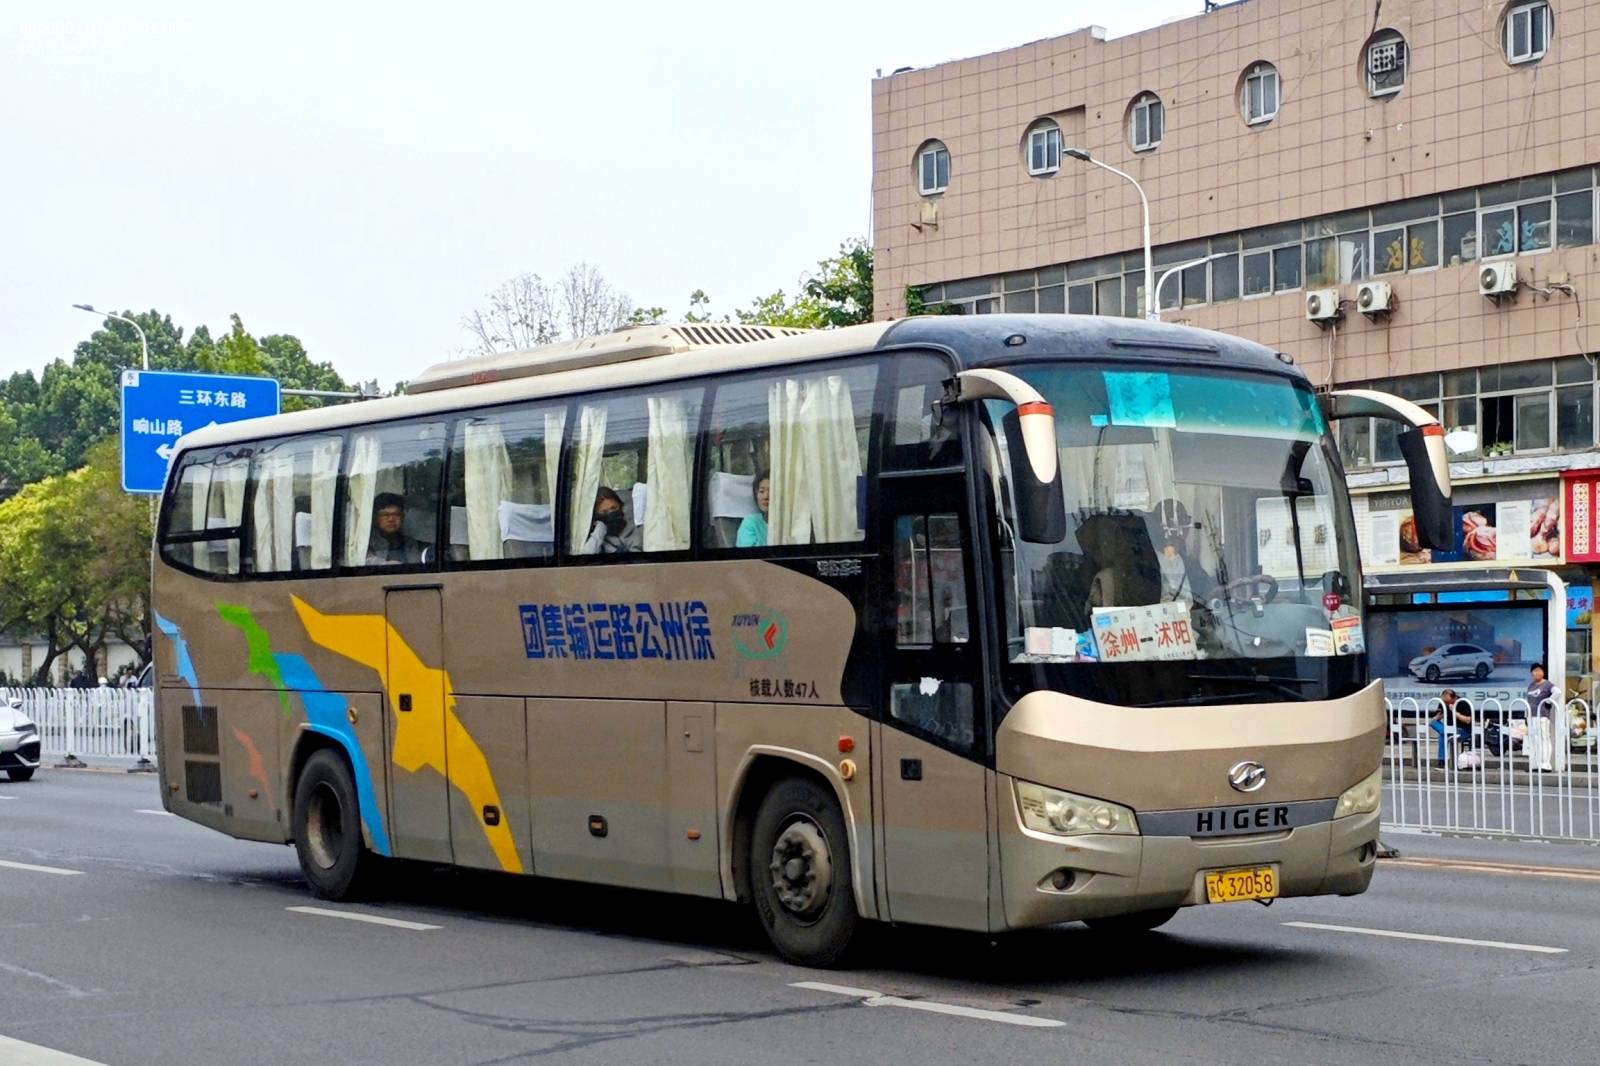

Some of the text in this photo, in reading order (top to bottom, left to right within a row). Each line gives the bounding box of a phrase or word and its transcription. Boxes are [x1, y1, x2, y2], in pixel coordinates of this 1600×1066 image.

[178, 389, 247, 408] 三环东路
[132, 417, 183, 436] 响山路
[1196, 806, 1290, 832] HIGER
